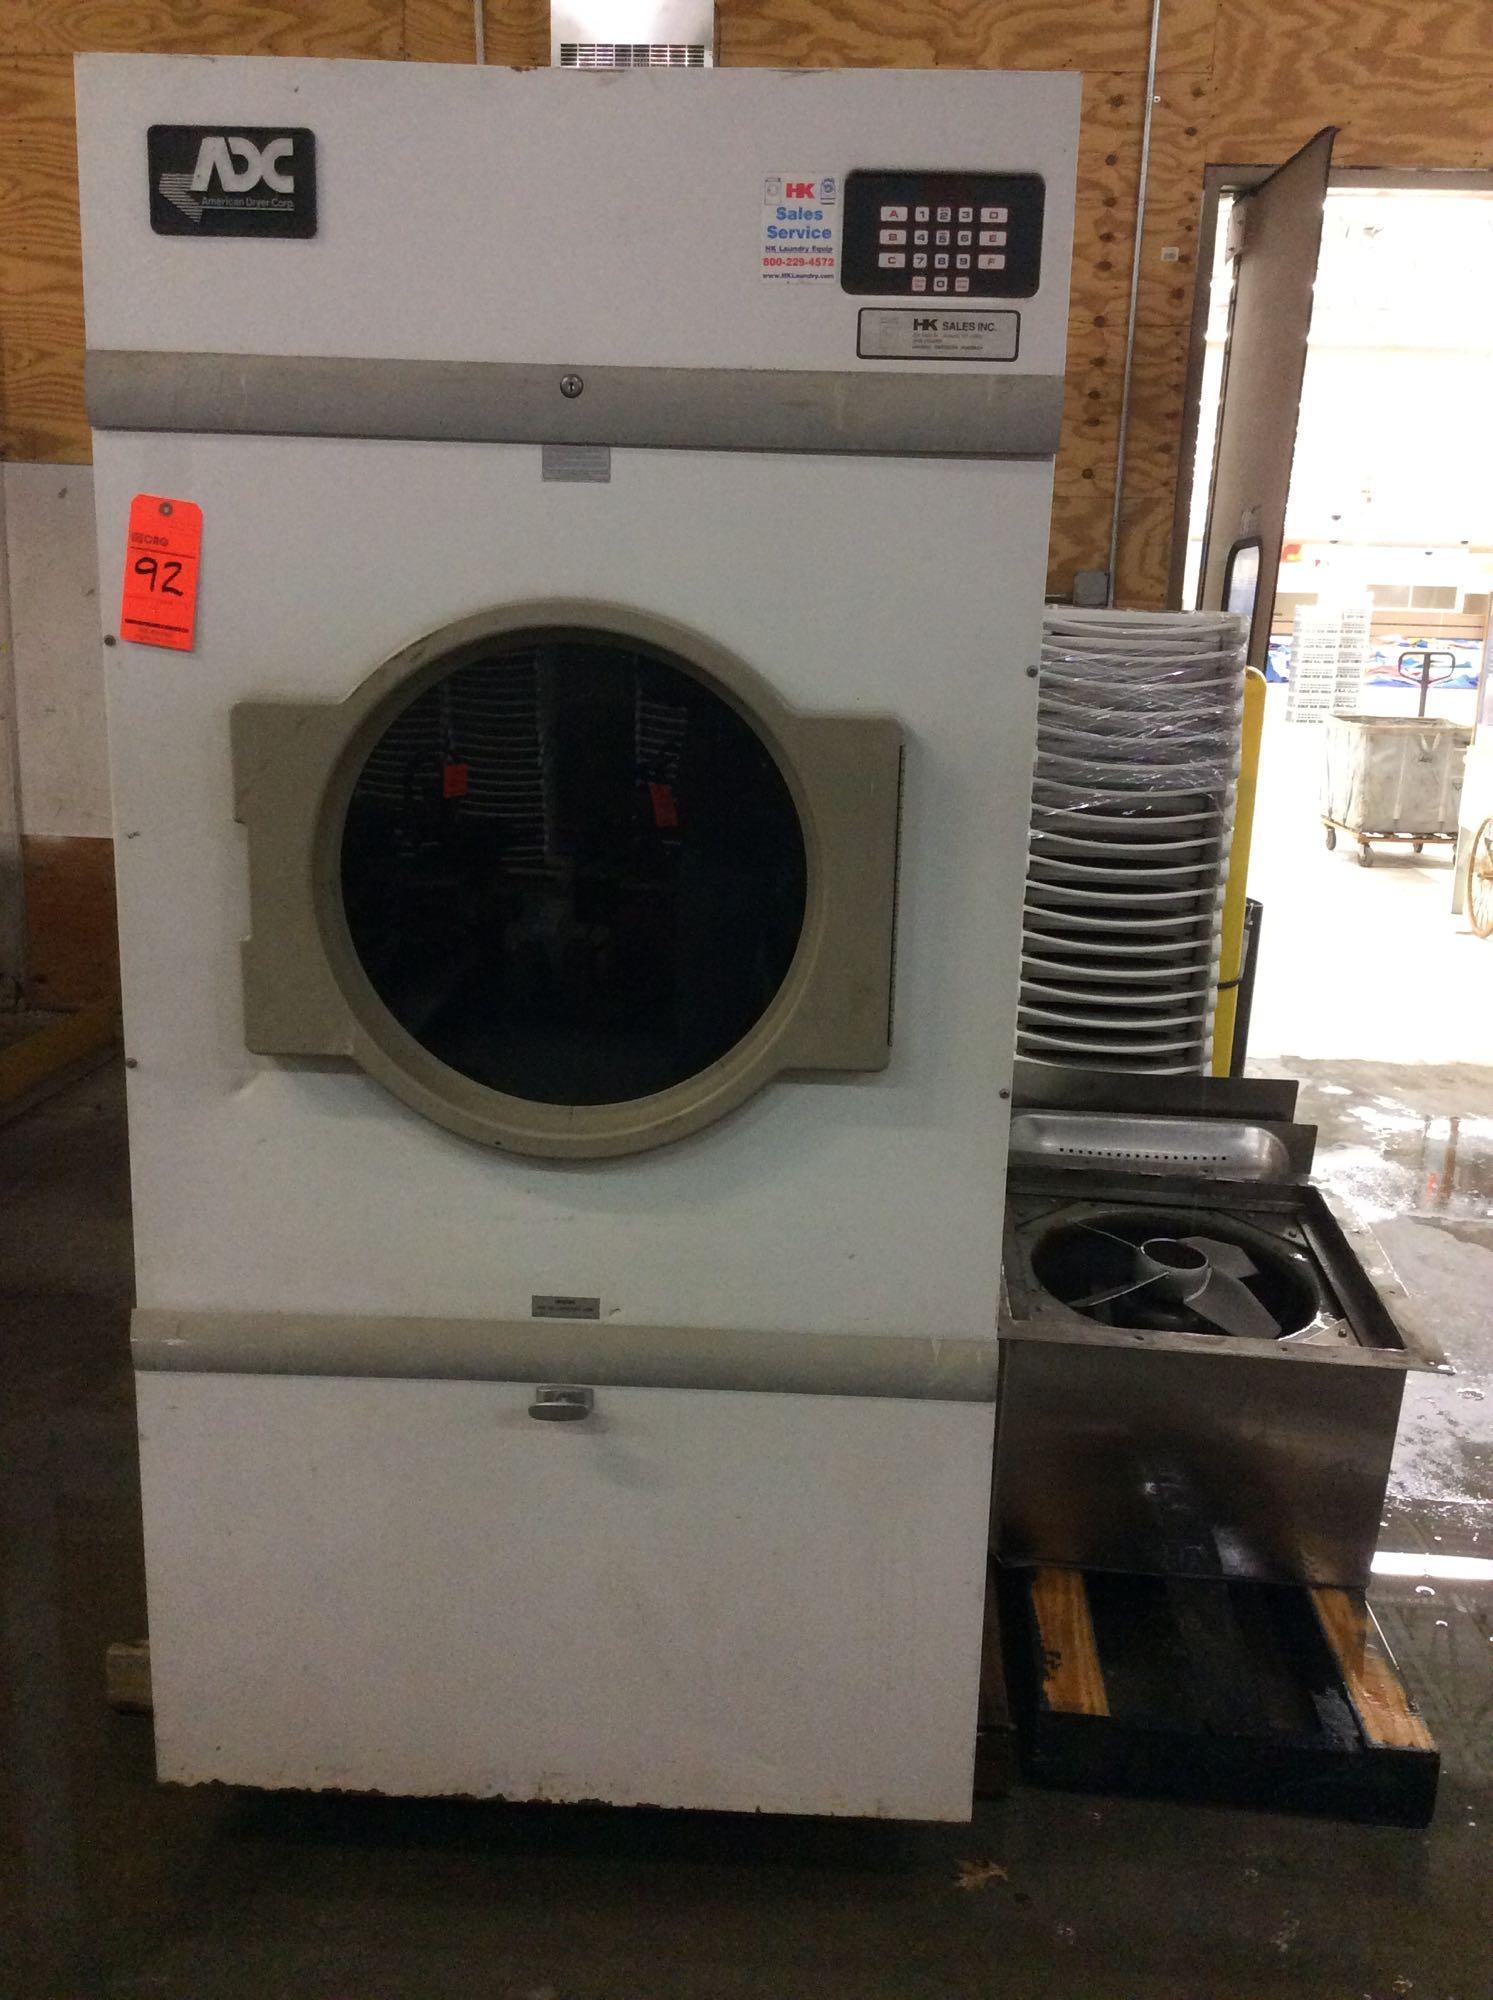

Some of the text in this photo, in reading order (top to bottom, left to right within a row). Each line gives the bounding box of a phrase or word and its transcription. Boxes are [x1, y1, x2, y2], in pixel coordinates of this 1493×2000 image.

[189, 136, 295, 194] ADC
[785, 182, 815, 199] HK
[201, 196, 246, 207] American
[246, 197, 270, 209] Dryer
[776, 206, 823, 221] Sales
[767, 225, 832, 240] Service
[765, 245, 833, 254] HK Laundry Equip
[913, 318, 998, 332] HK SALES INC.
[134, 556, 184, 597] 92
